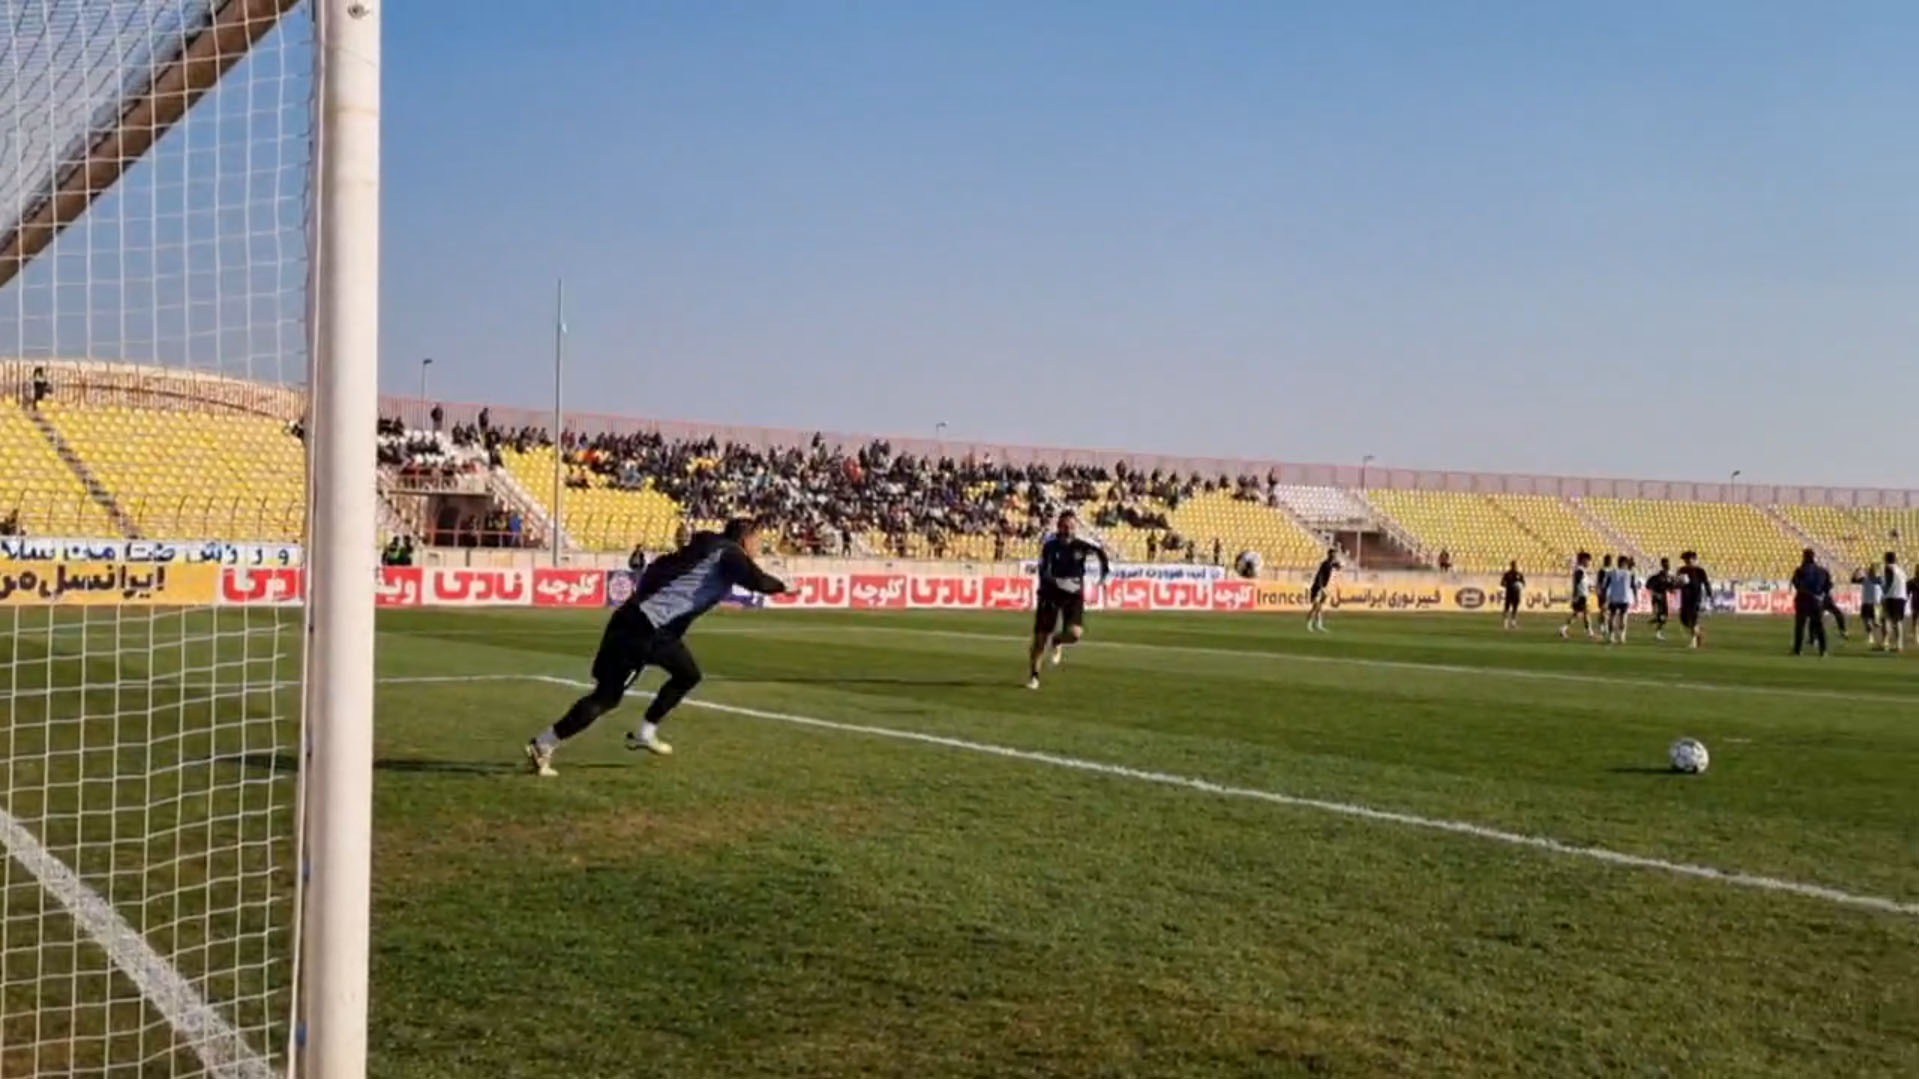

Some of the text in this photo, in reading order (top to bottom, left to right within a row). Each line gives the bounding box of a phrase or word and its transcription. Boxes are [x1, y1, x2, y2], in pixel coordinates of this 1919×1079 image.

[38, 563, 166, 599] ایرانسل
[536, 573, 601, 602] کلوچه
[851, 578, 905, 607] کلوچه
[1256, 587, 1312, 605] Irancel
